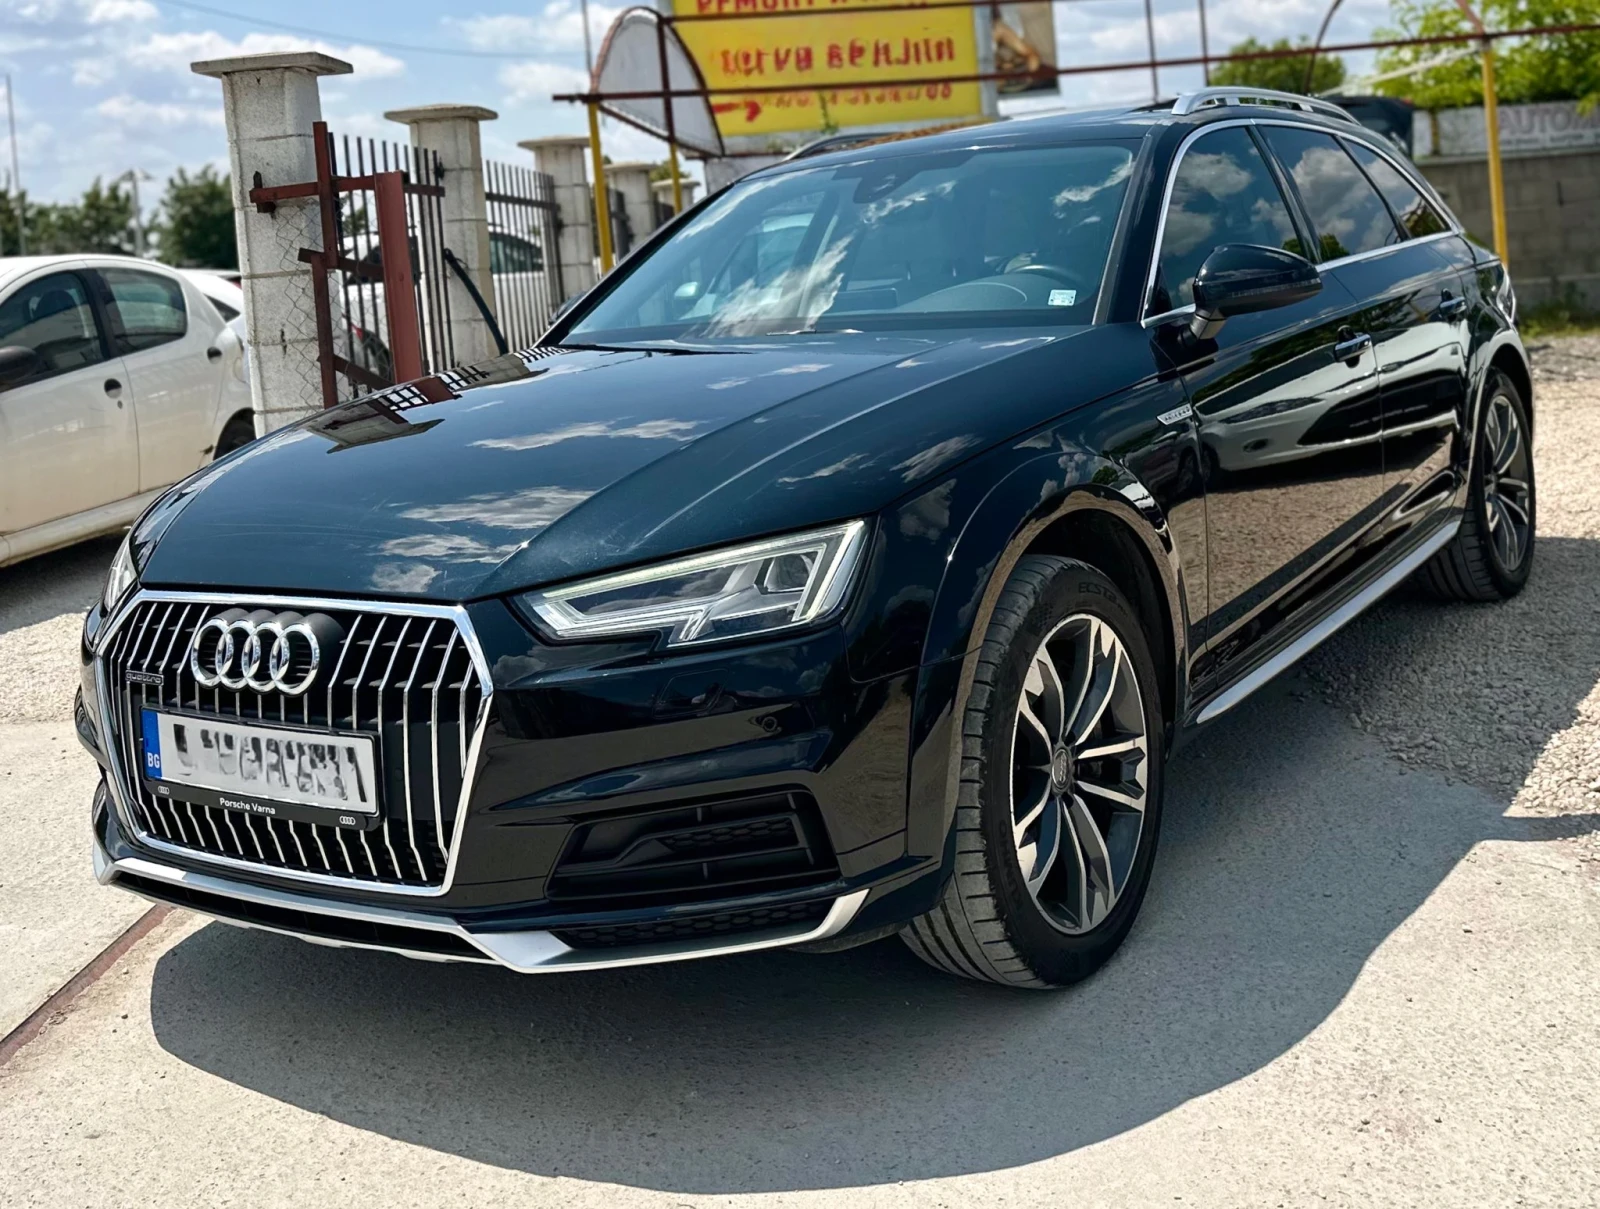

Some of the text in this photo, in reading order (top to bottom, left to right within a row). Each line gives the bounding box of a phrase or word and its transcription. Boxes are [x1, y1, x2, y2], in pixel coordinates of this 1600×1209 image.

[125, 672, 162, 685] quattro
[147, 752, 160, 769] BG
[219, 797, 276, 815] Porsche Varna
